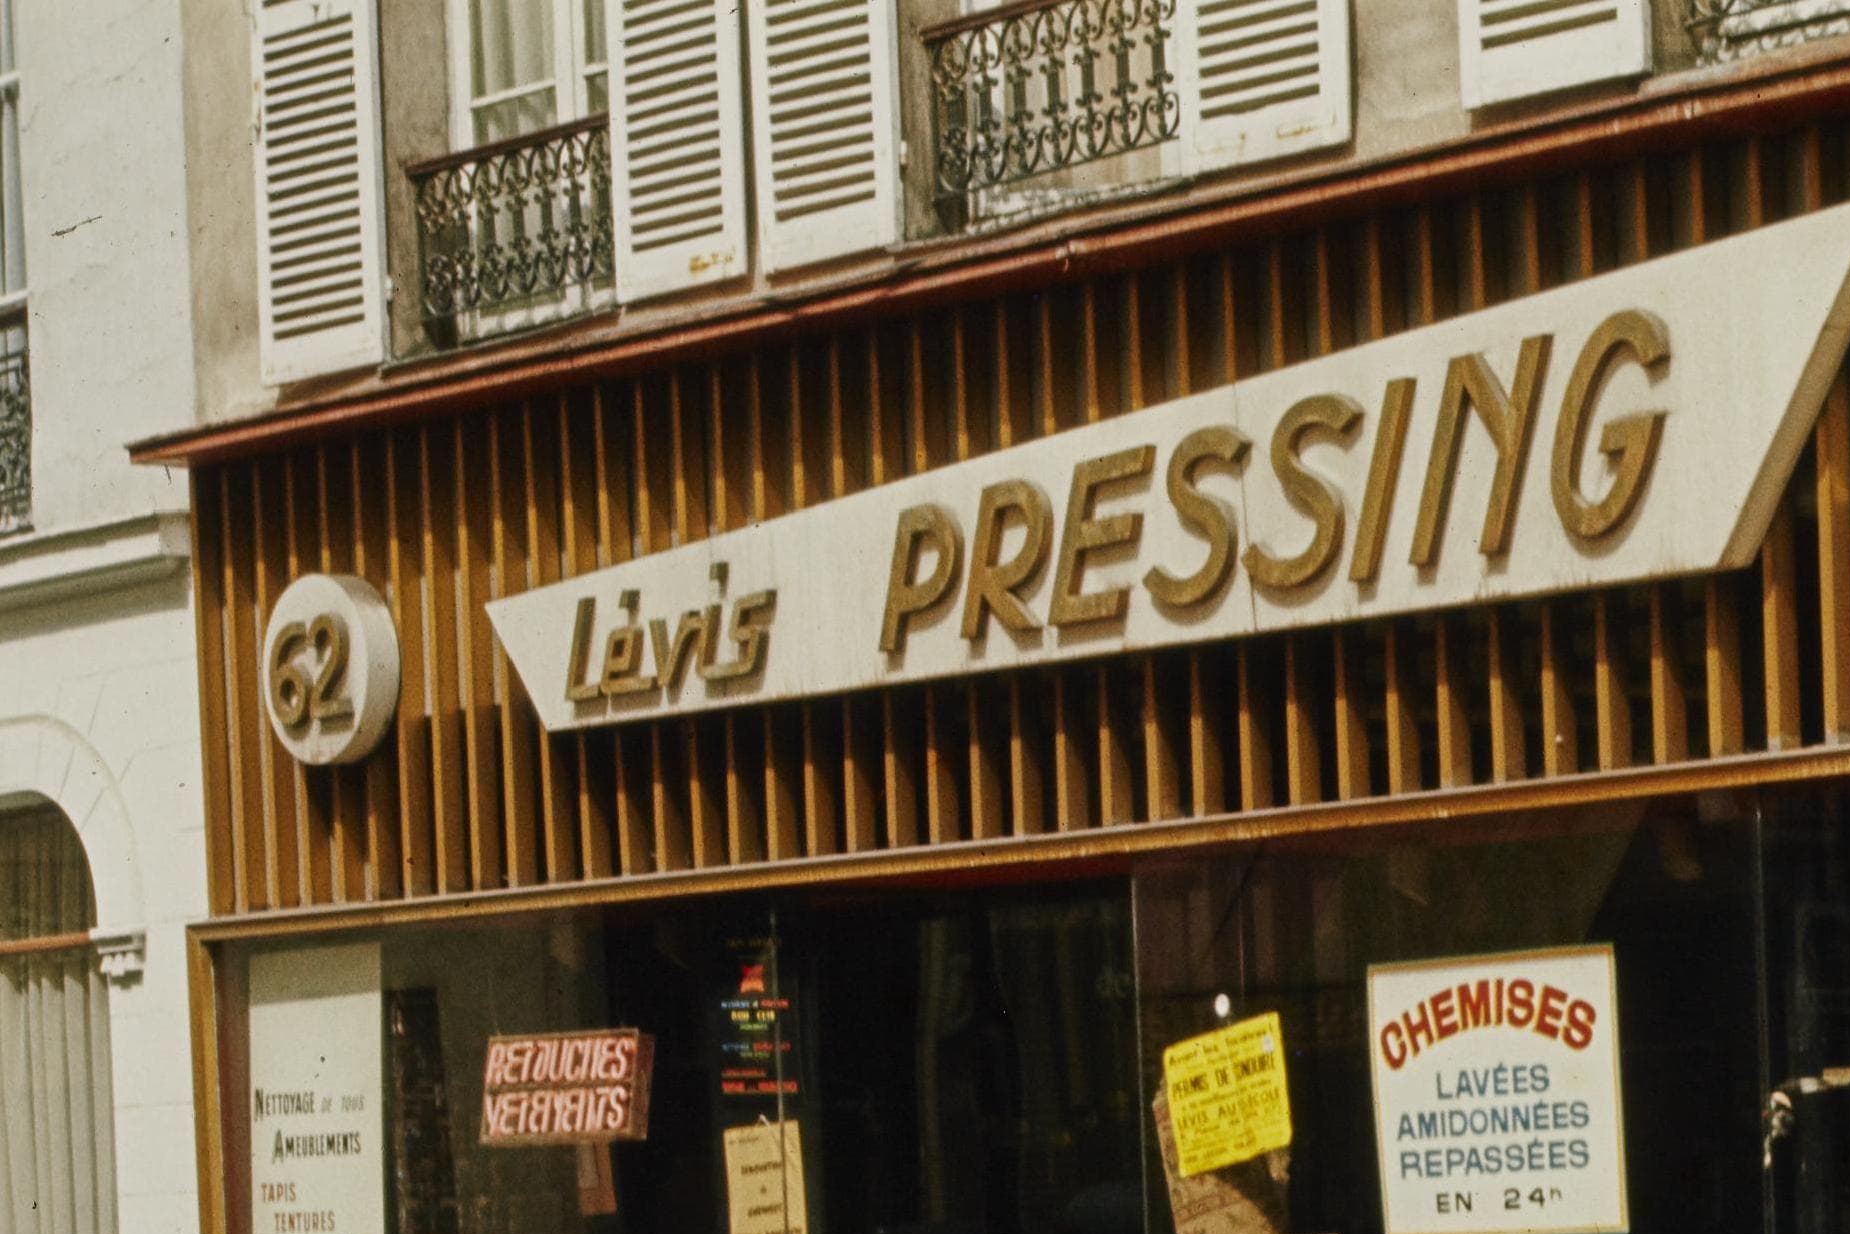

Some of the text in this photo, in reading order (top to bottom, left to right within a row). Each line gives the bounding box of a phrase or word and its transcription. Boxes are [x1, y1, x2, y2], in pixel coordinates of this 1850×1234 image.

[878, 308, 1672, 652] PRESSING
[269, 612, 355, 732] 62
[1380, 977, 1597, 1071] CHEMISES
[485, 1036, 633, 1084] RETOUCHES
[1436, 1062, 1551, 1101] LAVÉES
[254, 1087, 315, 1123] NETTOYAGE
[1396, 1099, 1591, 1142] AMIDONNÉES
[271, 1129, 362, 1164] AMEUBLEMENTS
[1400, 1138, 1591, 1180] REPASSÉES
[261, 1182, 296, 1203] TAPIS
[1436, 1187, 1563, 1213] EN 24h
[274, 1210, 336, 1234] TENTURES
